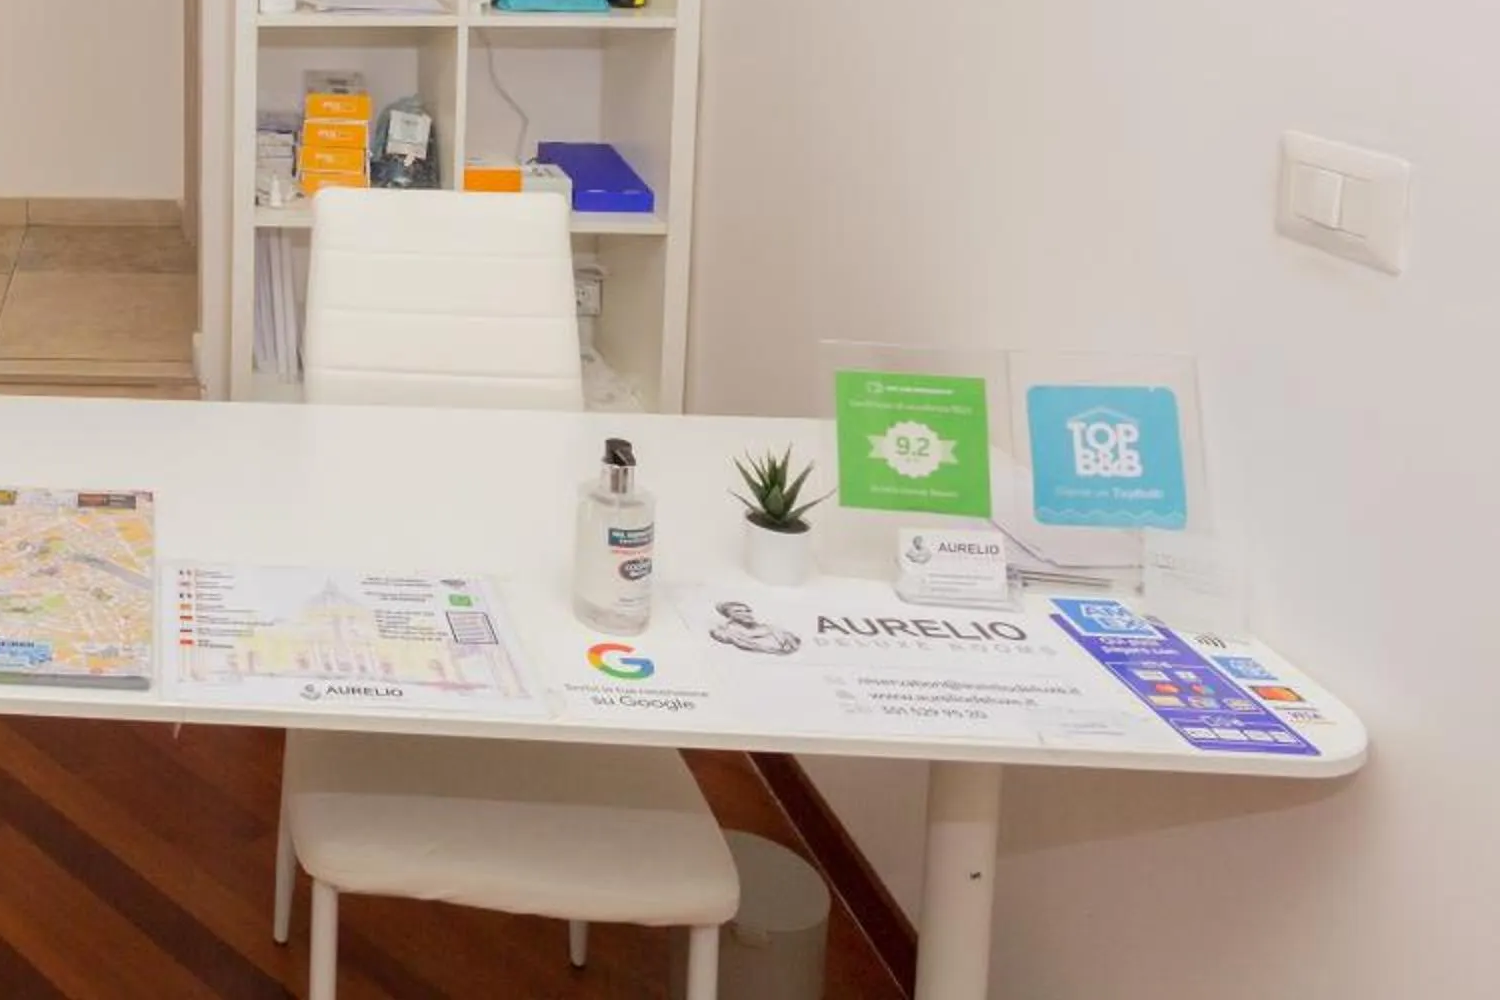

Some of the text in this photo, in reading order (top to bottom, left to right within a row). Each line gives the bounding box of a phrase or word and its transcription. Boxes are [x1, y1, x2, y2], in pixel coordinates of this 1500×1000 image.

[895, 435, 931, 458] 9.2
[1066, 420, 1140, 450] TOP
[1075, 449, 1143, 478] B&B
[938, 541, 1000, 556] AURELIO
[816, 614, 1028, 642] AURELIO
[326, 685, 404, 697] AURELIO
[590, 694, 697, 711] su Google
